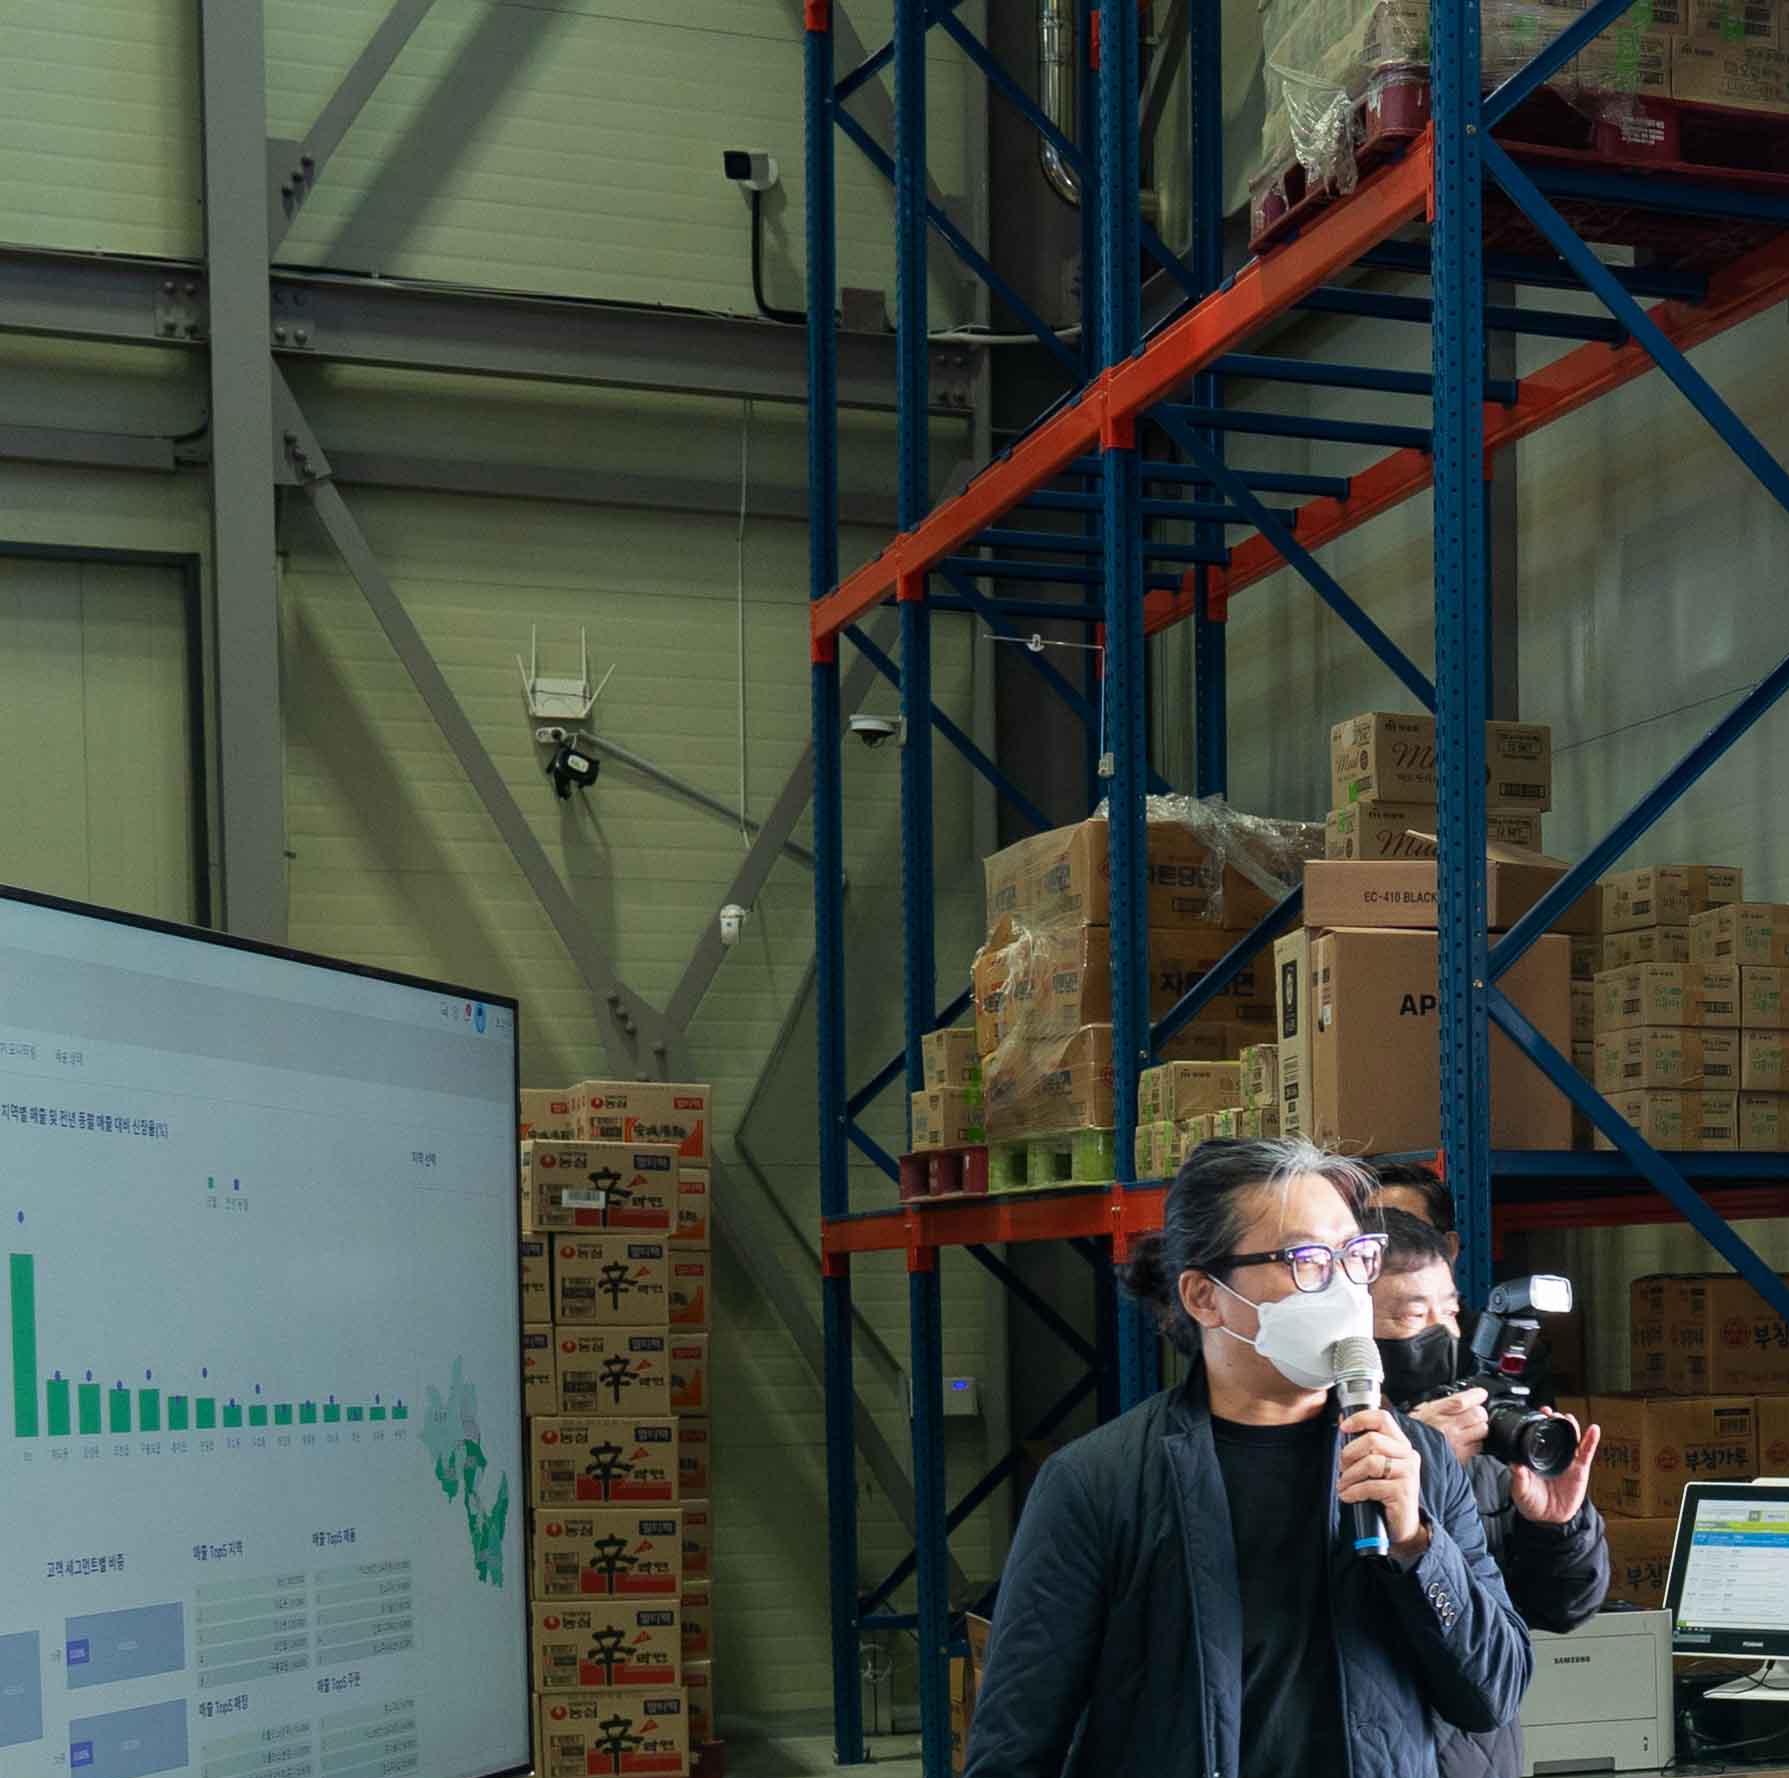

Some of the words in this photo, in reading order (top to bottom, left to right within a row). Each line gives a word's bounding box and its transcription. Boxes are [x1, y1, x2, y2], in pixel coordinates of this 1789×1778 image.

[598, 1262, 638, 1310] 辛
[600, 1356, 637, 1404] 辛
[586, 1442, 633, 1502] 辛
[1686, 1451, 1748, 1470] 부침가루
[591, 1534, 638, 1594] 辛
[588, 1626, 636, 1686] 辛
[1553, 1655, 1591, 1665] SAMSUNG
[596, 1714, 643, 1775] 辛
